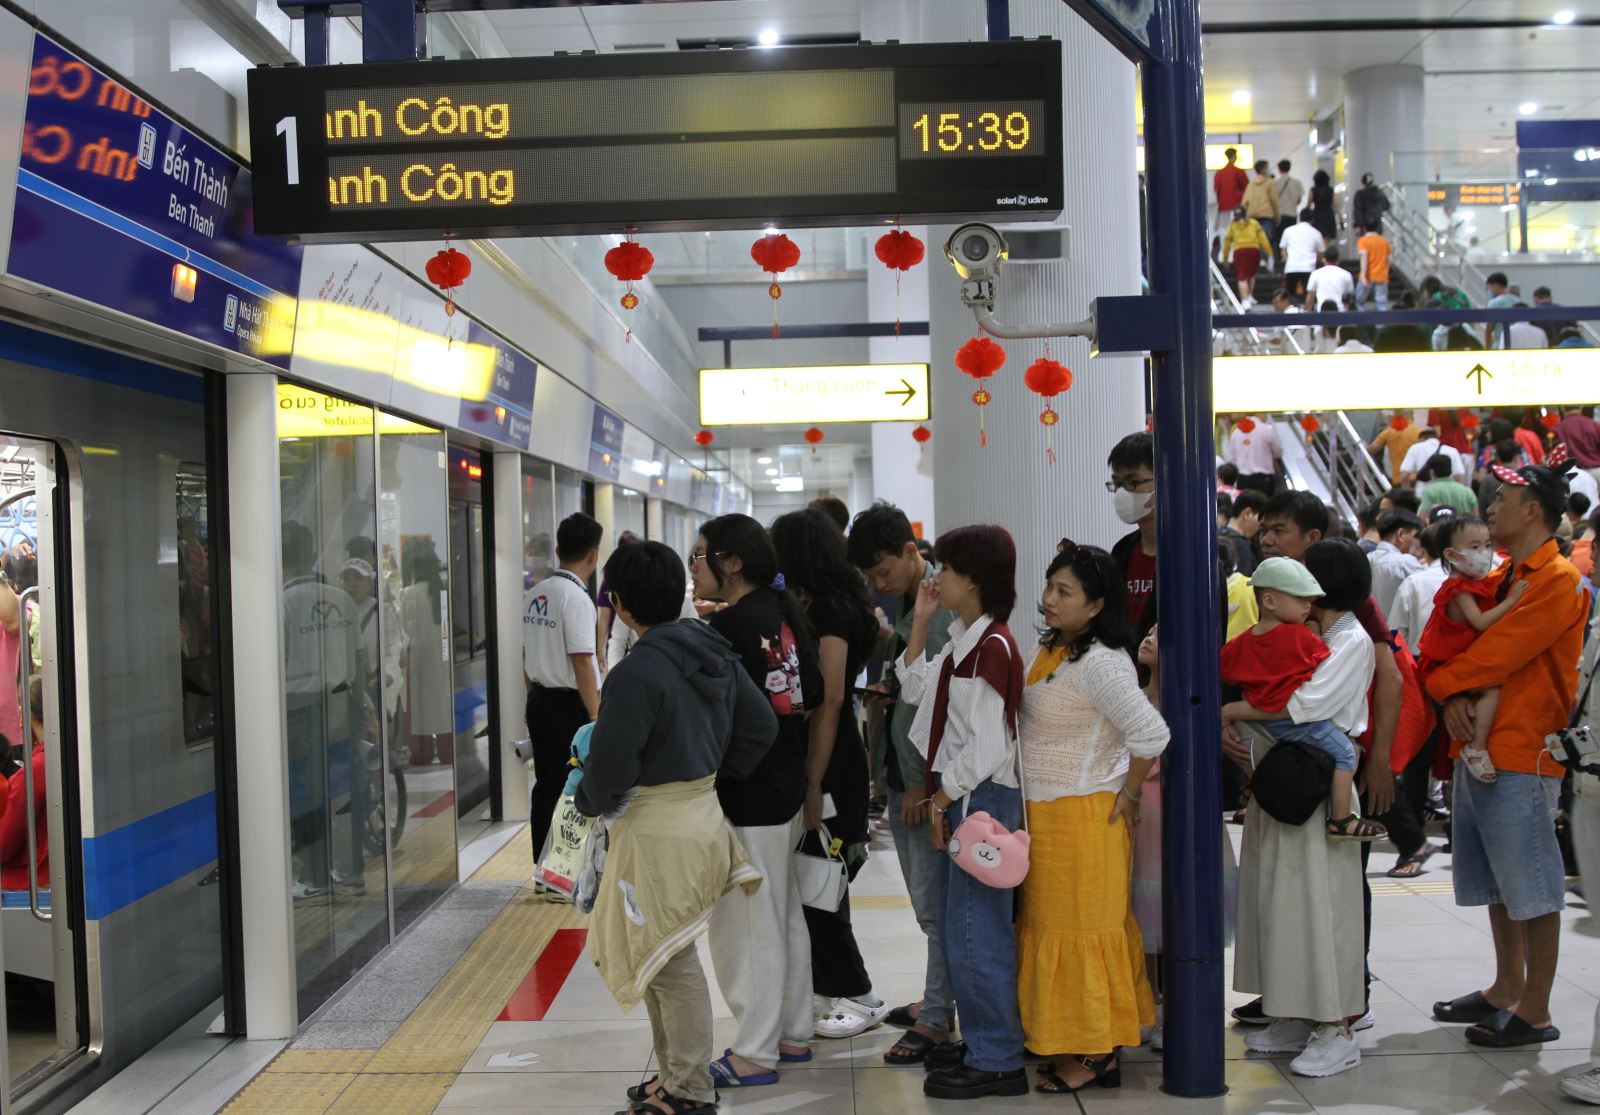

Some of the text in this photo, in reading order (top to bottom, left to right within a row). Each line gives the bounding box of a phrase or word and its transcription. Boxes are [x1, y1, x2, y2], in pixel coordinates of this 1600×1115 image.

[396, 97, 510, 139] Công
[913, 112, 1030, 152] 15:39
[276, 116, 300, 185] 1
[163, 140, 228, 208] Bến Thành
[401, 164, 514, 206] Công
[168, 193, 214, 239] Ben Thanh
[997, 195, 1048, 205] solari udine
